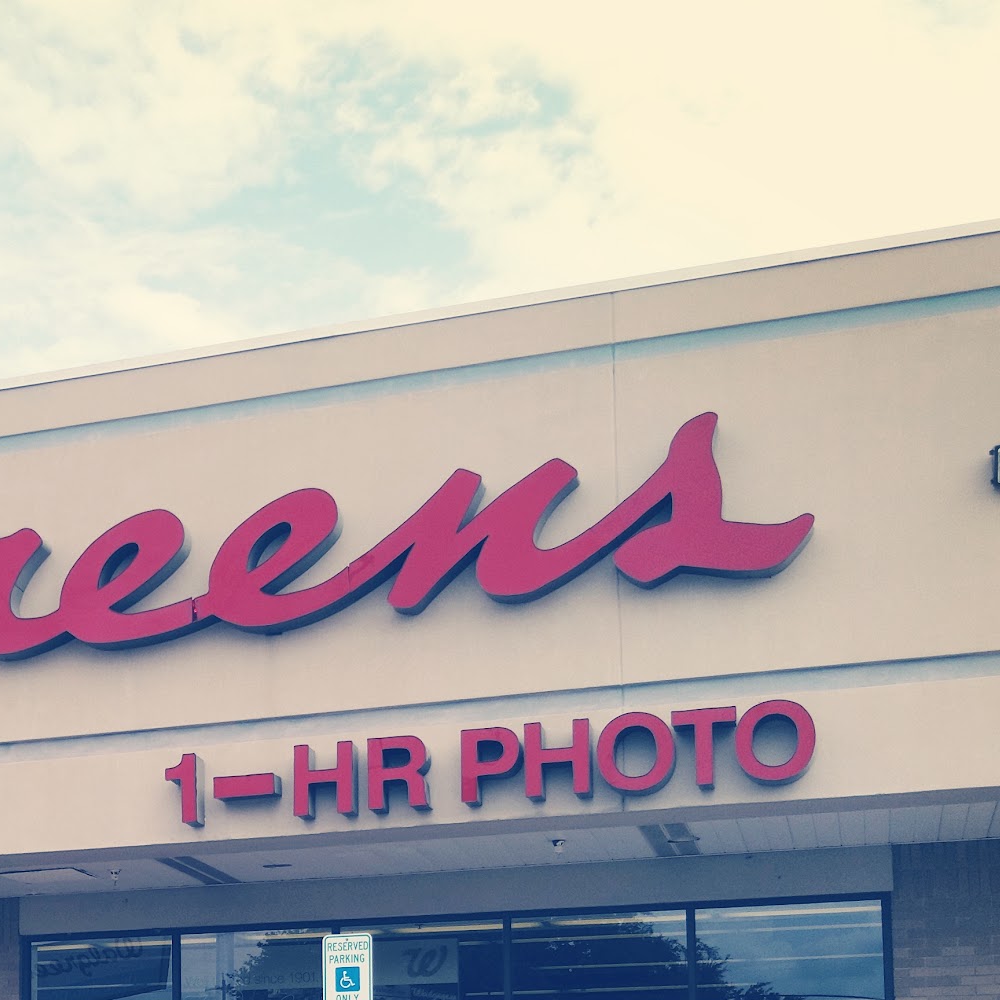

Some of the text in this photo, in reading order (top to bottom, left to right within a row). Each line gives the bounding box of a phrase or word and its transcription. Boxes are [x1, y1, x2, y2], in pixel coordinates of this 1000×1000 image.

[164, 699, 818, 828] 1-HR PHOTO
[327, 941, 369, 952] RESERVED
[329, 953, 365, 964] PARKING
